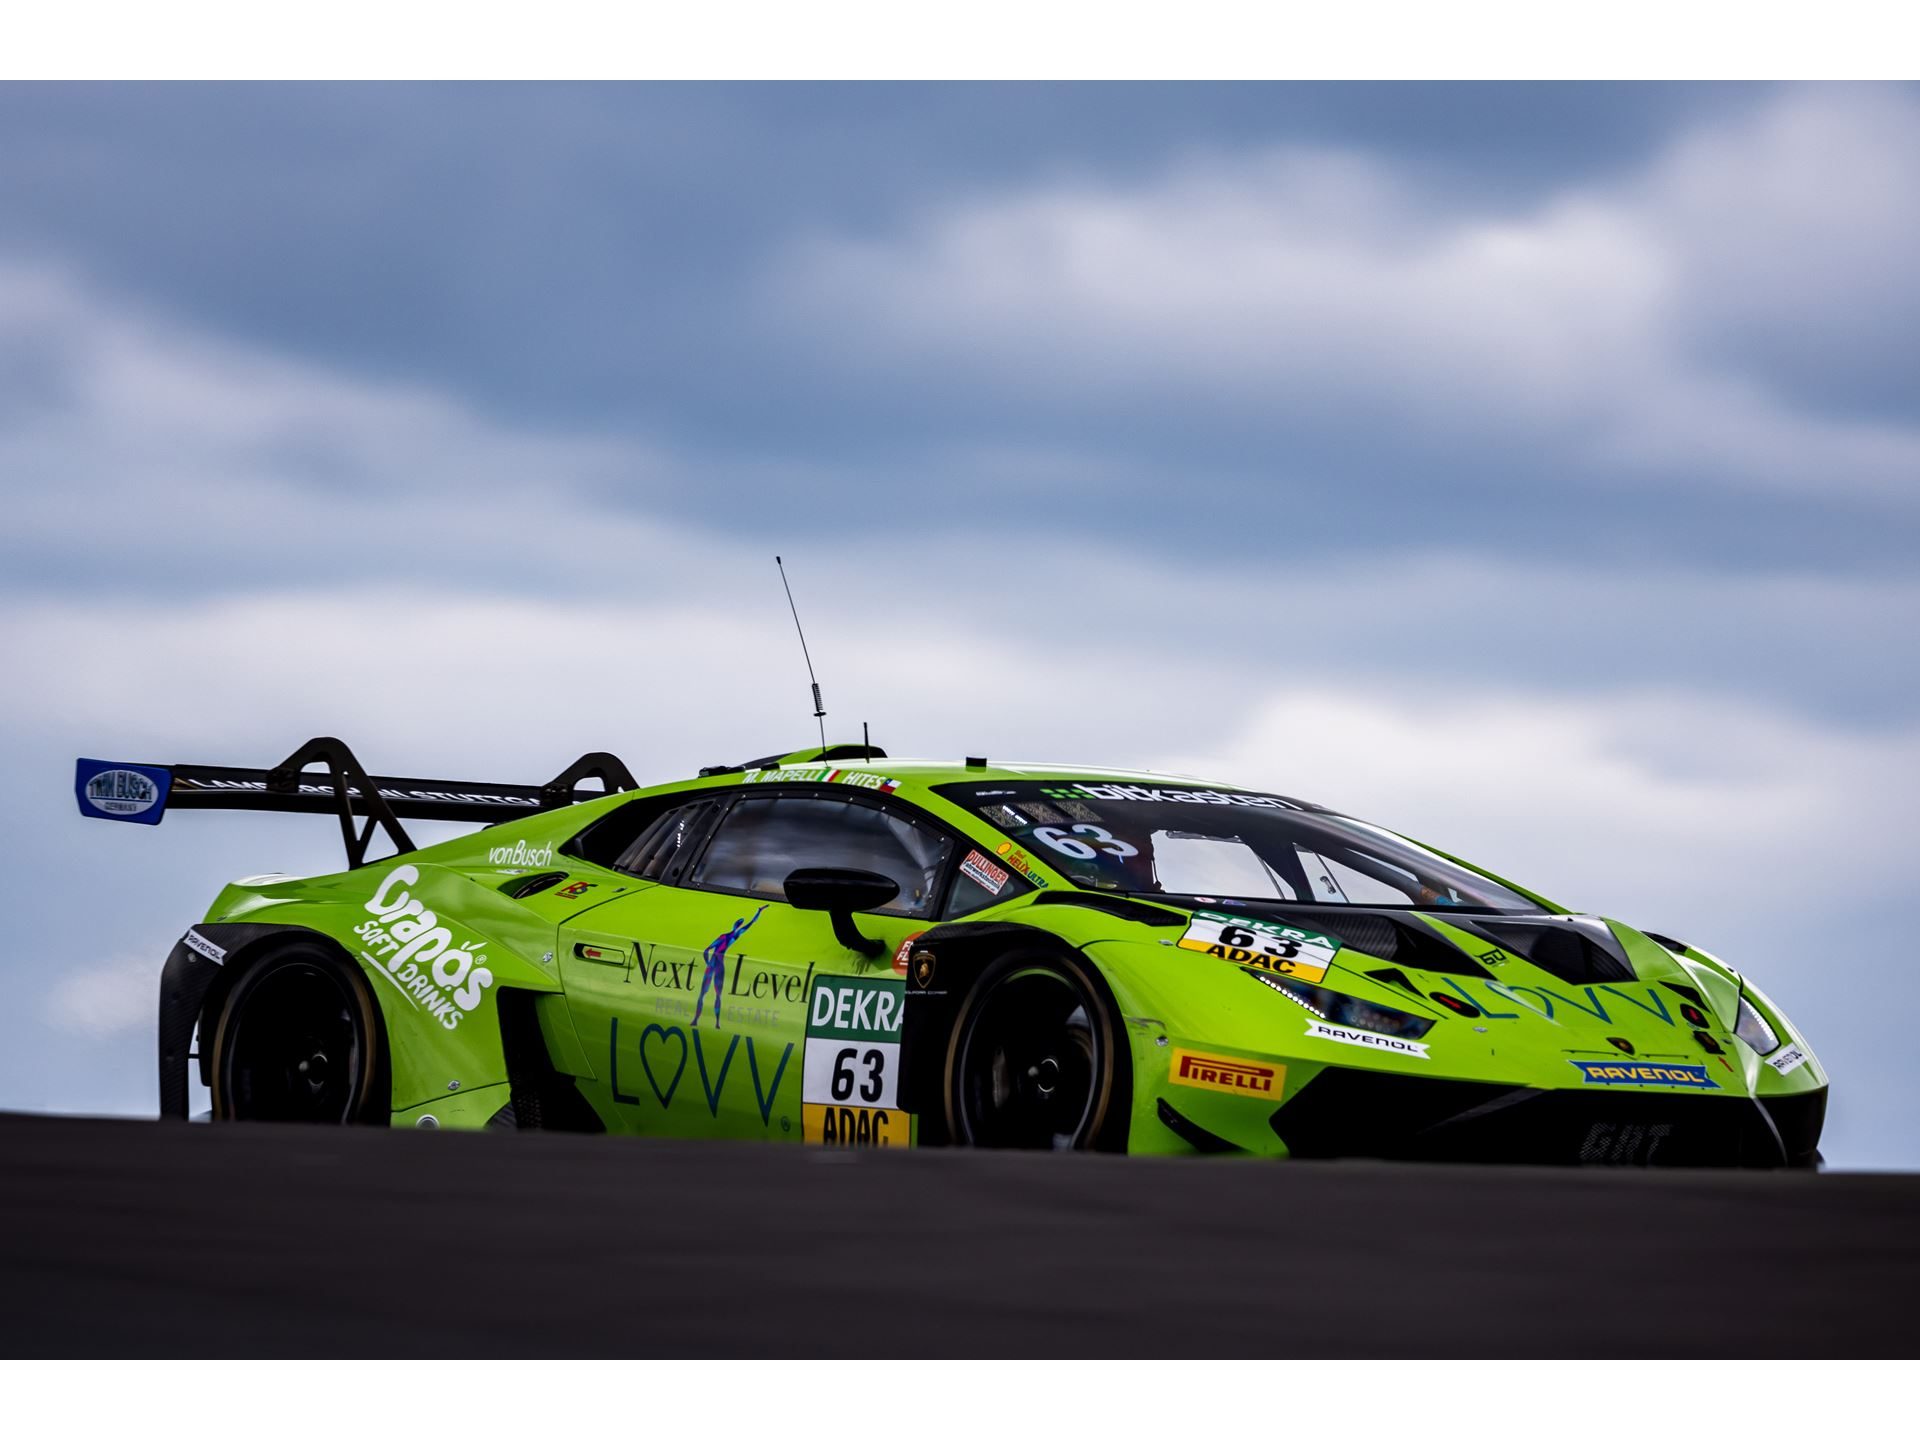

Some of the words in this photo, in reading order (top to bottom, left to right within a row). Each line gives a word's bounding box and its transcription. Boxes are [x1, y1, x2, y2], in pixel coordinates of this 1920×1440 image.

[118, 771, 154, 801] BUSCH
[760, 769, 819, 783] MAPELLI
[841, 771, 886, 790] HITES
[1032, 823, 1139, 861] 63
[967, 851, 1008, 885] DULLINGER
[1007, 854, 1031, 875] HELIX
[1027, 871, 1049, 889] ULTRA
[353, 920, 400, 957] SOFT
[1198, 911, 1334, 949] DEKRA
[1218, 925, 1303, 959] 63
[187, 933, 221, 960] RAVENOL
[1206, 943, 1297, 974] ADAC
[623, 941, 699, 992] Next
[728, 953, 815, 1004] Level
[396, 962, 464, 1030] DRINKS
[655, 996, 691, 1017] REAL
[727, 1005, 781, 1027] ESTATE
[1317, 1024, 1419, 1053] RAVENOL
[831, 1047, 885, 1103] 63
[1178, 1055, 1275, 1092] PIRELLI
[1586, 1065, 1706, 1083] RAVENOL
[823, 1106, 890, 1146] ADAC
